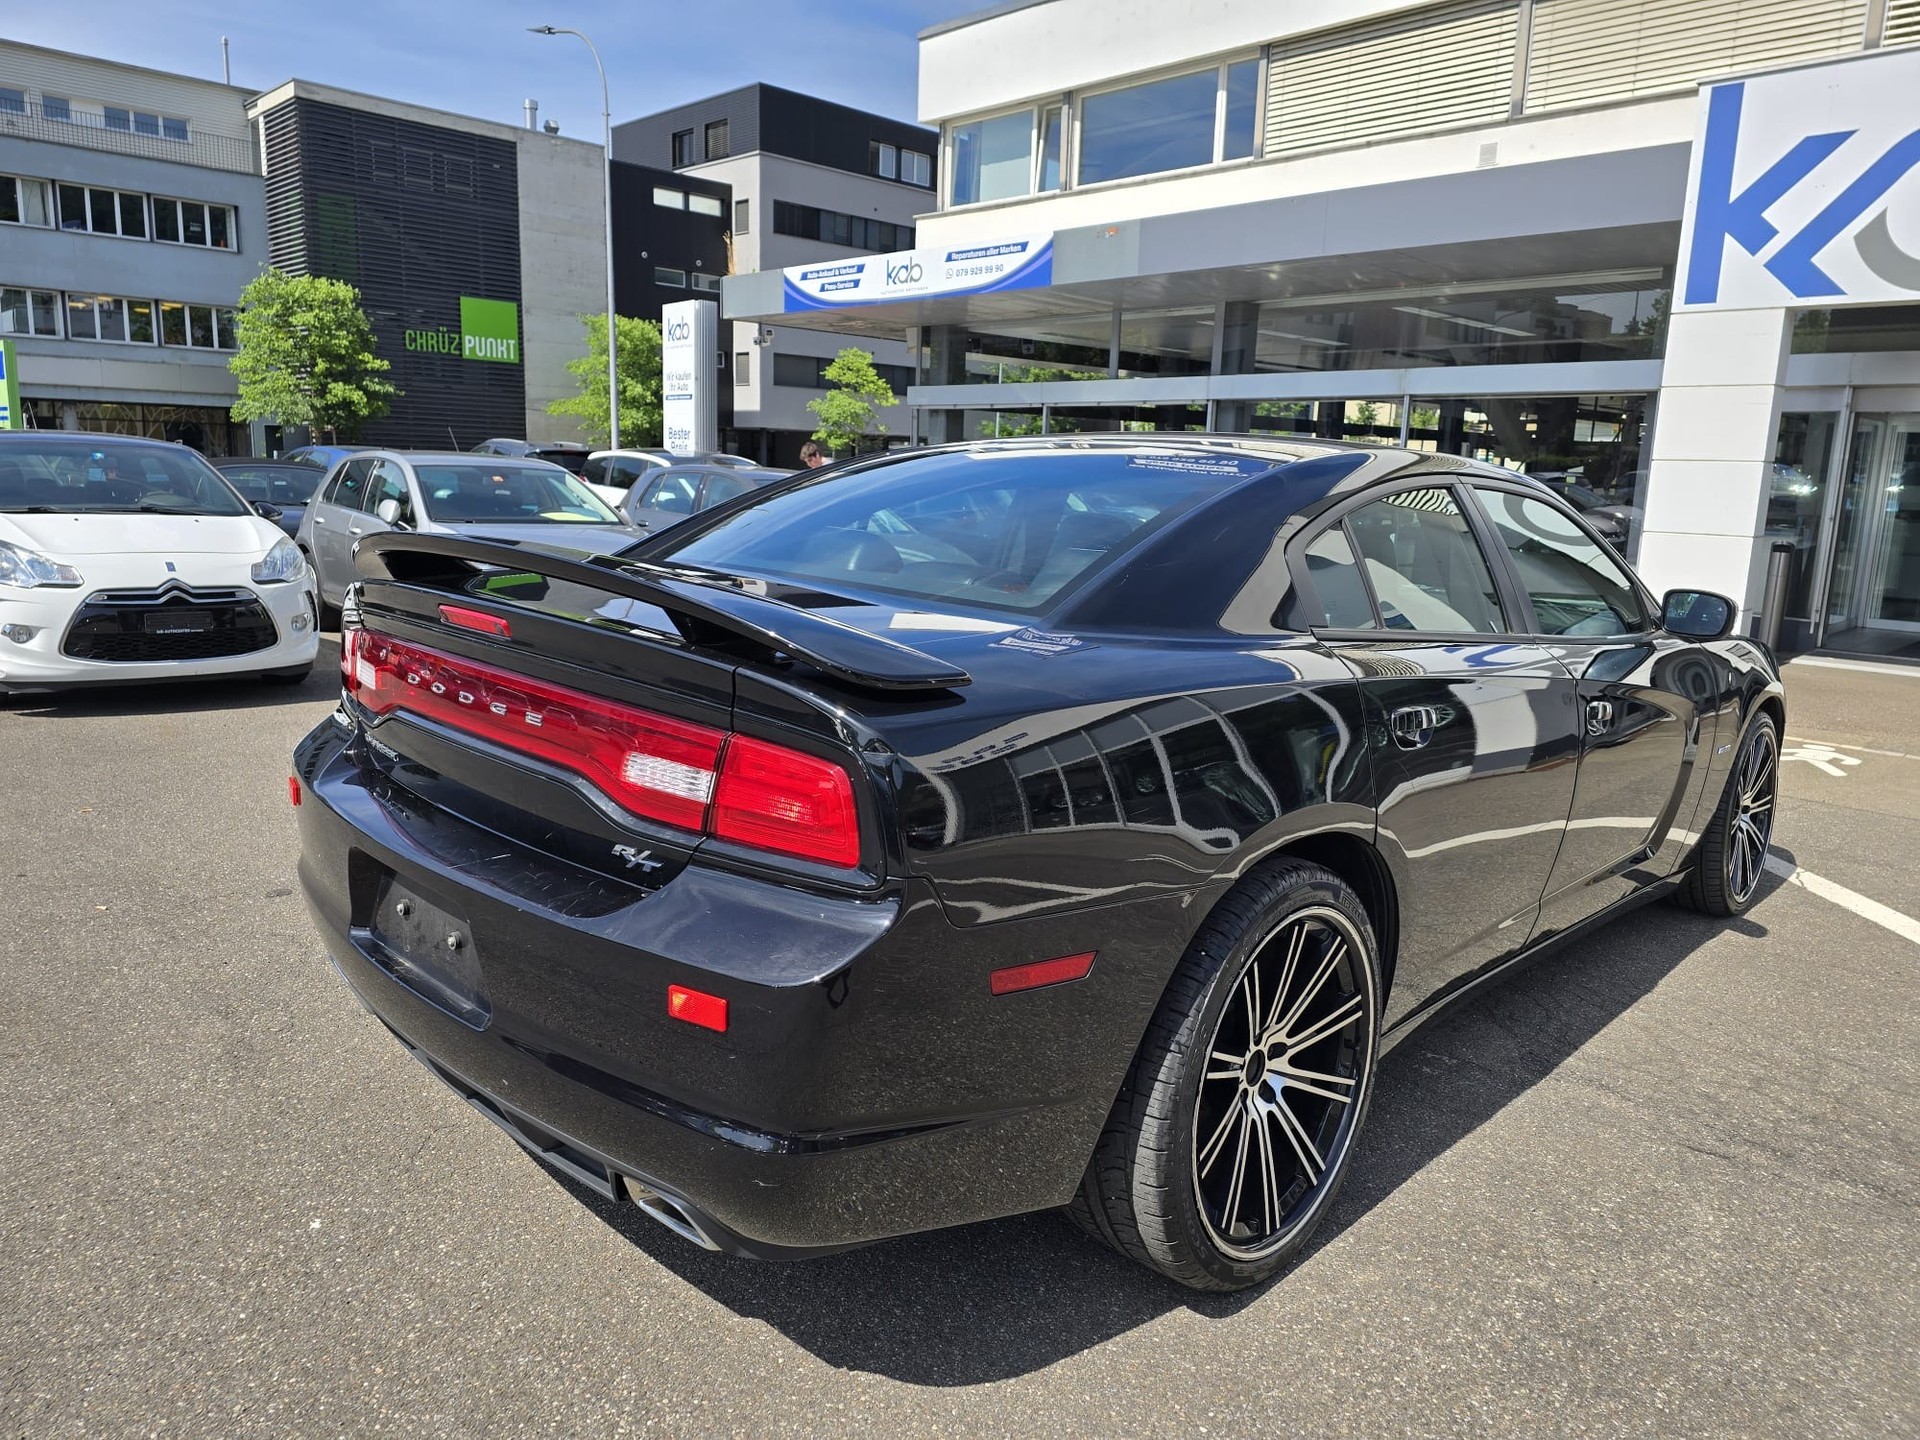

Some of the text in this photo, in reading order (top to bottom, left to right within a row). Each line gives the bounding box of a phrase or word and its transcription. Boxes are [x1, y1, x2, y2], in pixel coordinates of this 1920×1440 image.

[951, 244, 1022, 261] Reparaturen aller Marken
[839, 265, 858, 275] Verkauf
[886, 256, 923, 286] kab
[956, 263, 1004, 277] 079 929 99 90
[824, 280, 855, 291] Pneu-Service
[667, 316, 690, 342] kab
[405, 326, 516, 360] CHRÜZ PUNKT
[668, 427, 691, 440] Bester
[407, 672, 543, 727] DODGE
[611, 844, 665, 872] R/T
